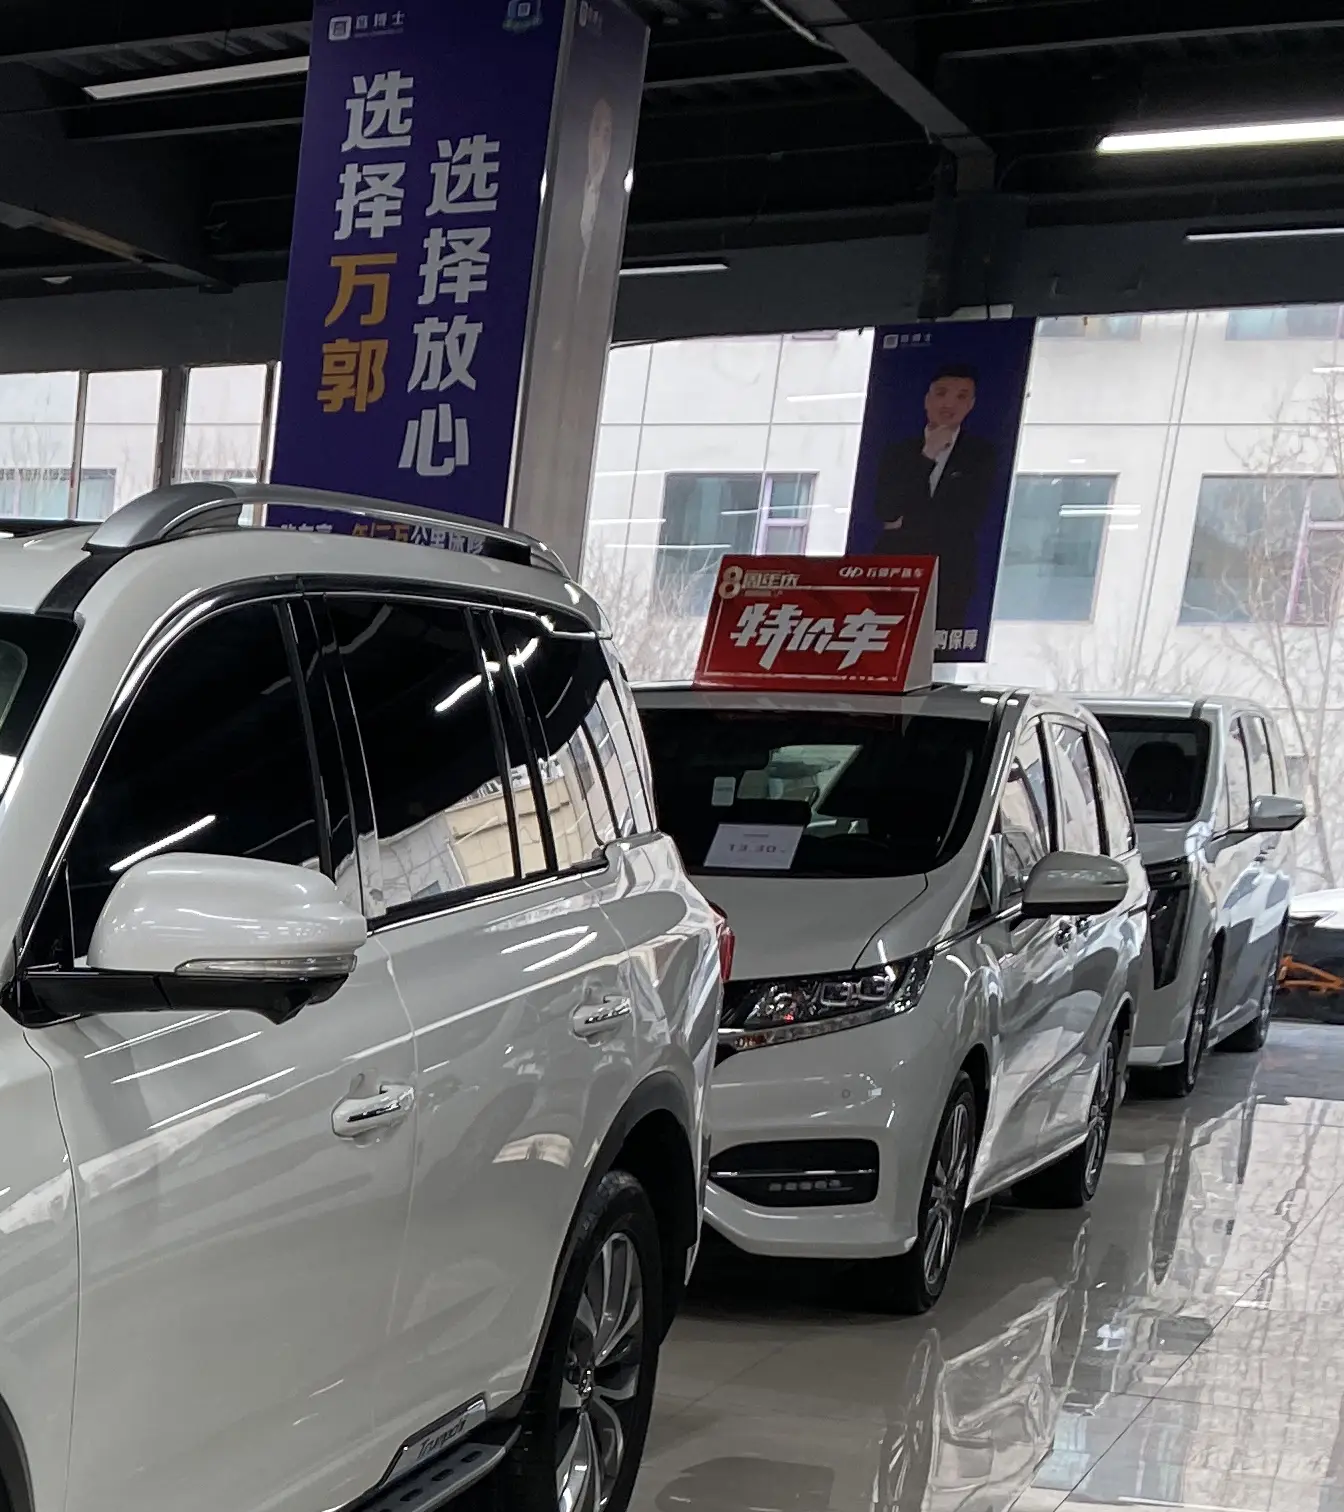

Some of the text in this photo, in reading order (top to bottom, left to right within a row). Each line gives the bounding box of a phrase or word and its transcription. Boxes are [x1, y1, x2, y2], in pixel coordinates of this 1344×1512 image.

[318, 70, 414, 412] 选择万郭
[398, 134, 500, 476] 选择放心
[730, 603, 905, 670] 特价车
